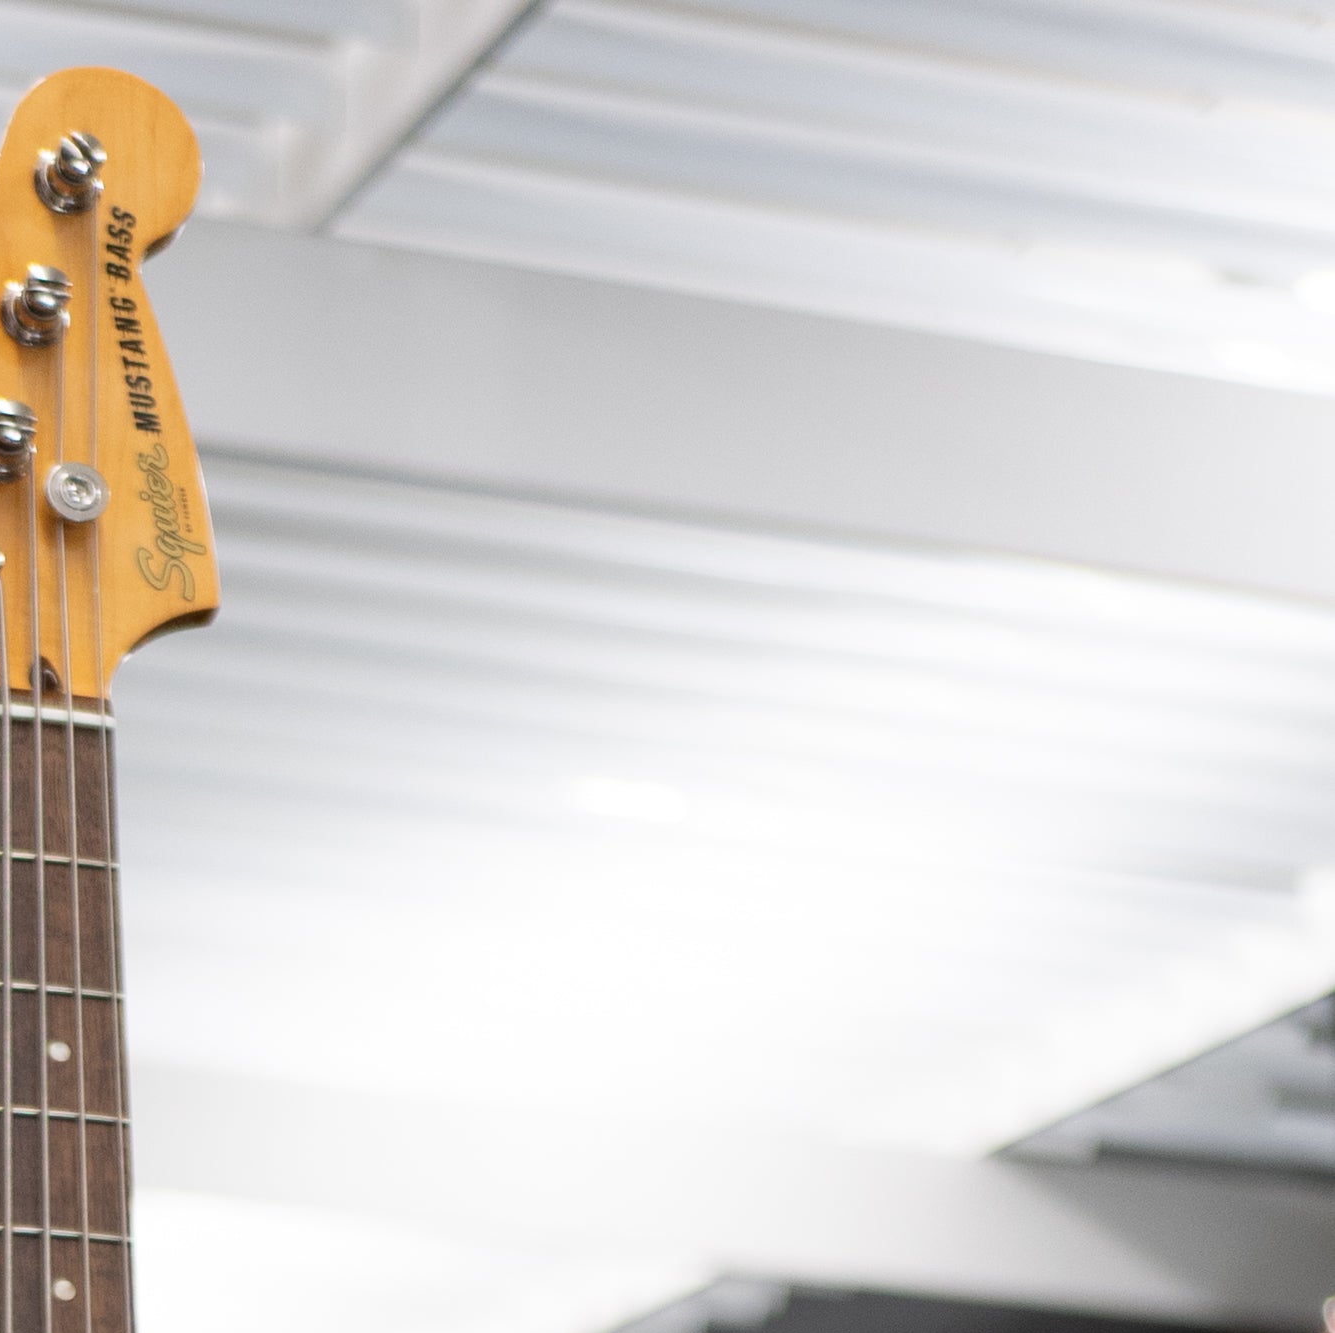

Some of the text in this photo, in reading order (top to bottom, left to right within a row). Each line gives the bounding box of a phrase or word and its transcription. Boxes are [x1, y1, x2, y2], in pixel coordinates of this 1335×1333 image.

[105, 206, 162, 434] MUSTANG BASS
[137, 442, 207, 602] Squier
